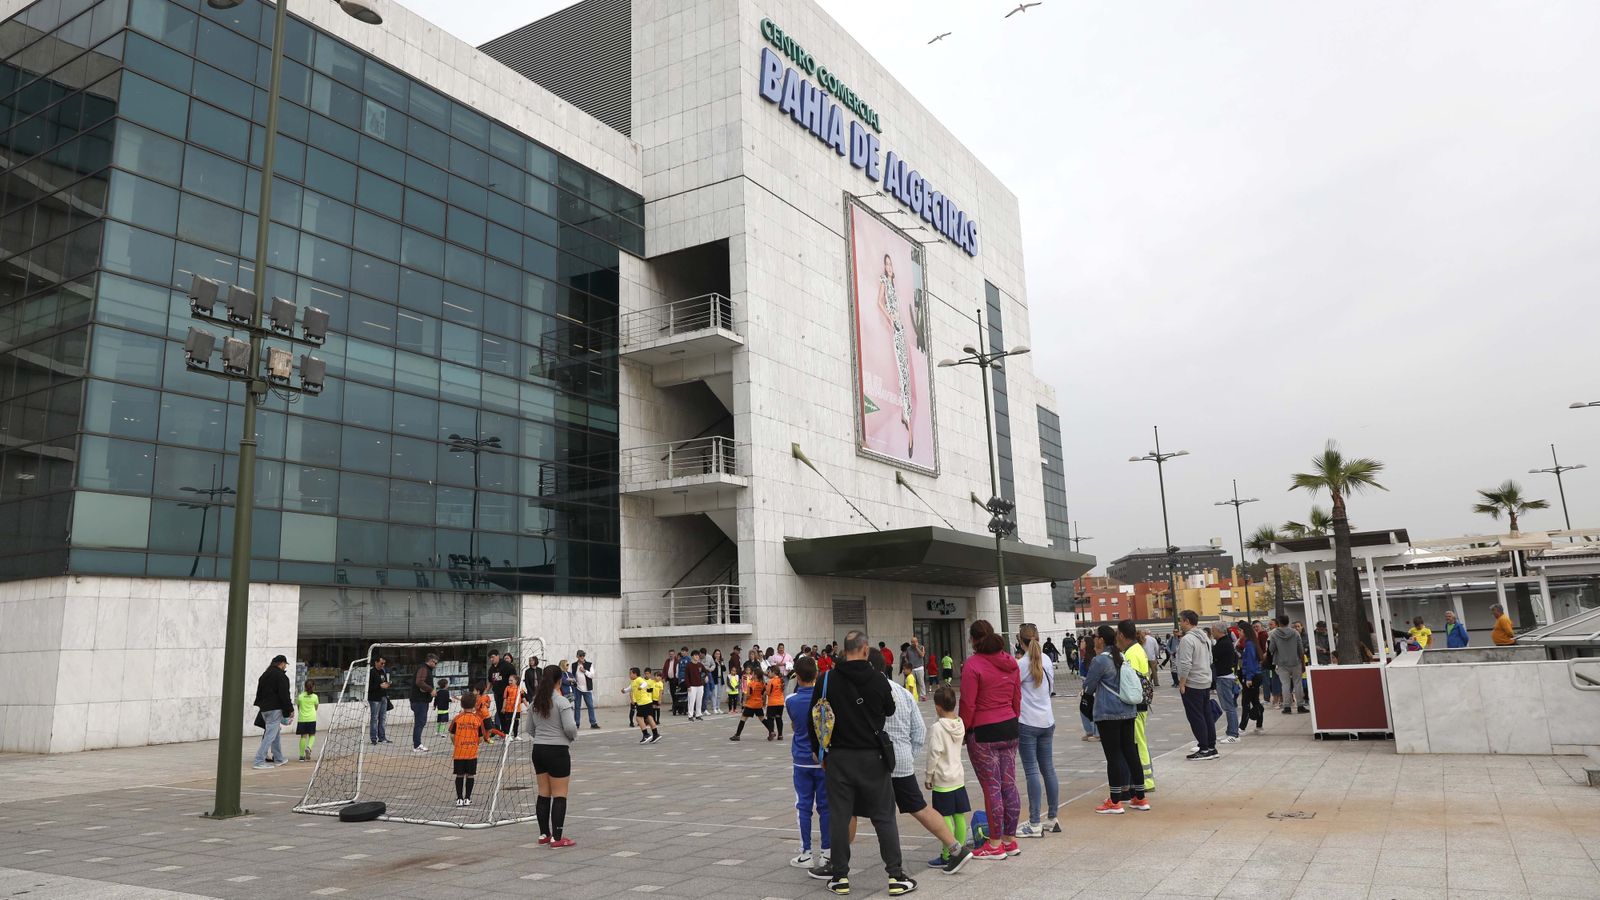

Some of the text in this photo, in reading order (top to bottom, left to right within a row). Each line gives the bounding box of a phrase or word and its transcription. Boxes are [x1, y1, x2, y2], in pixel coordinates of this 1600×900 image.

[759, 47, 978, 257] BAHÍA DE ALGECIRAS
[760, 17, 882, 133] CENTRO COMERCIAL
